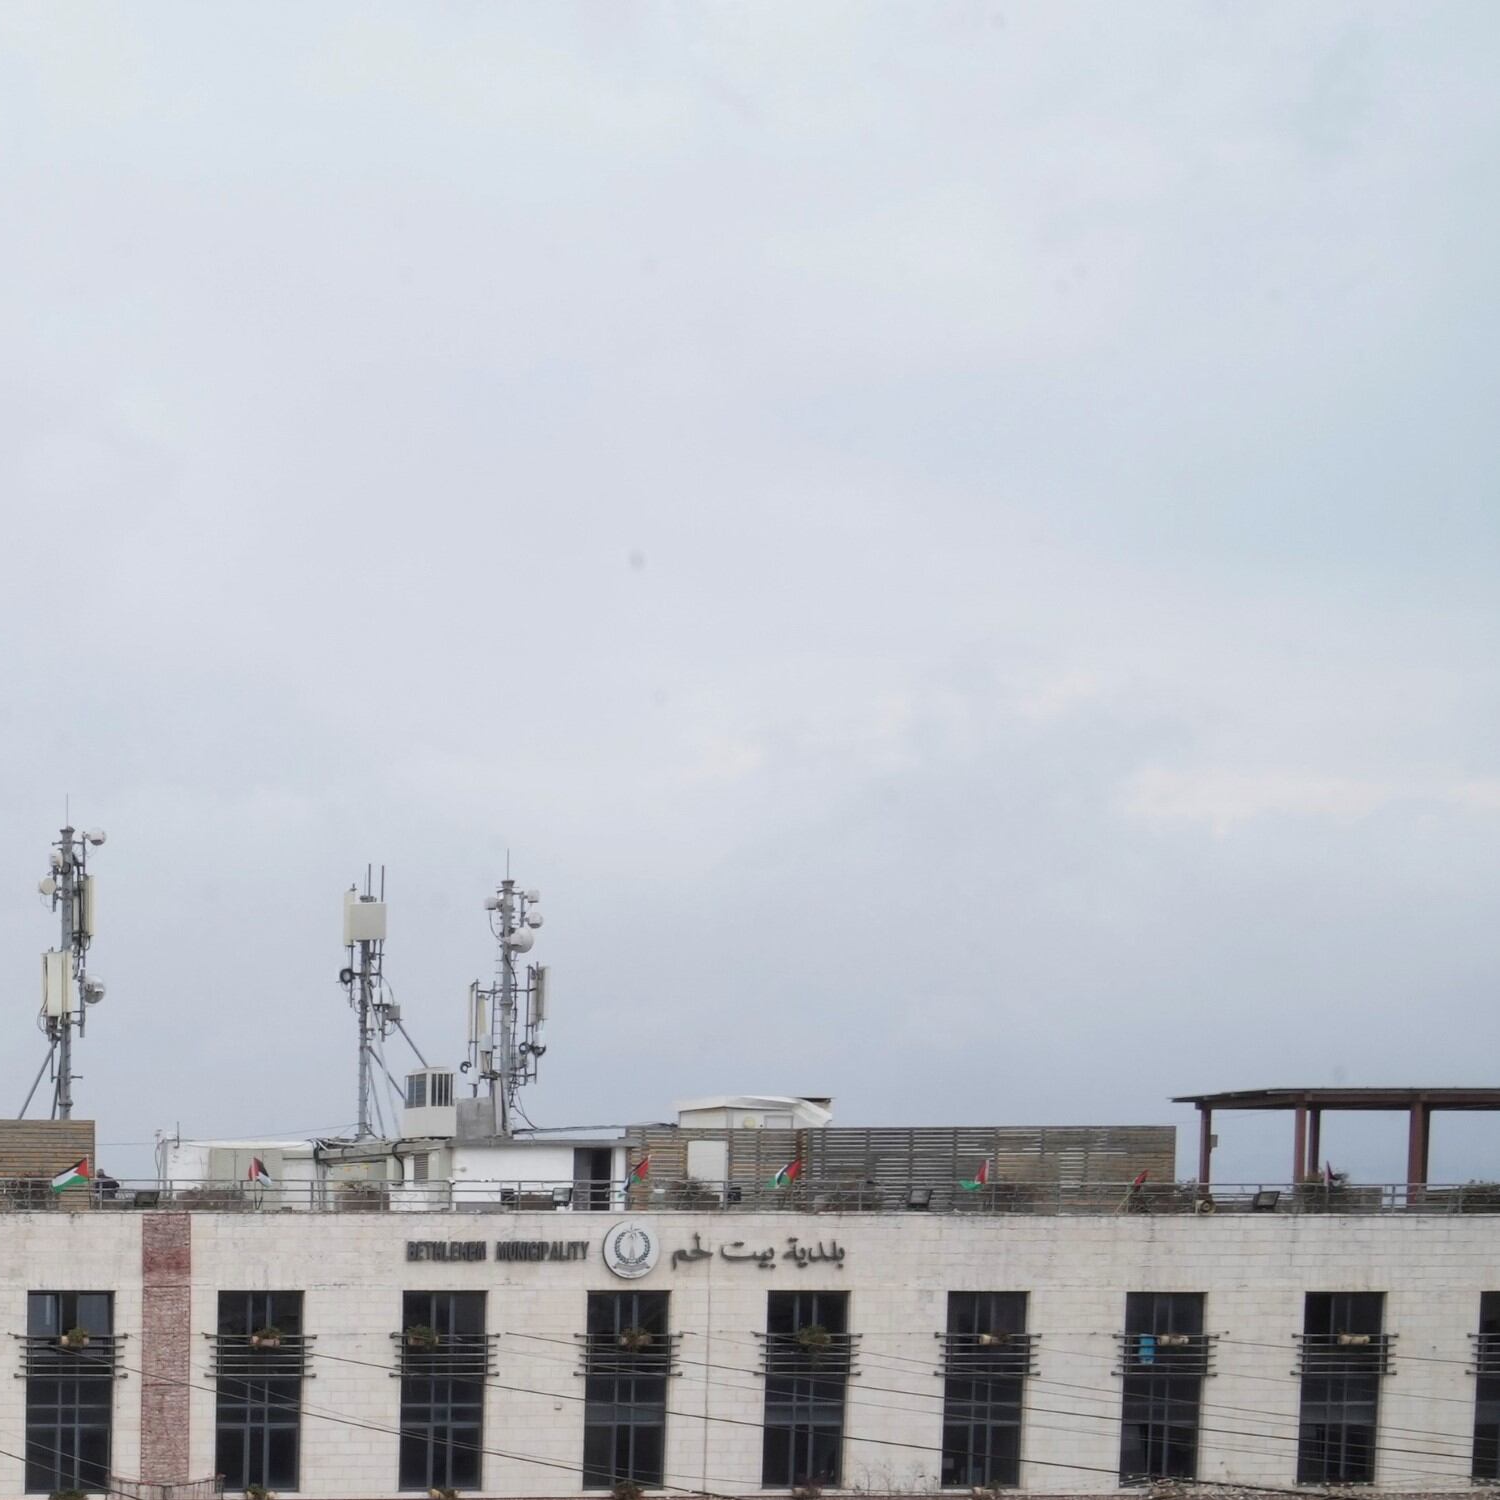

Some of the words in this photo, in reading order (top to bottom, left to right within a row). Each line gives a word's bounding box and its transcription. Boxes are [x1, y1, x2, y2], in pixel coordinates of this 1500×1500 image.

[406, 1241, 487, 1262] BETHLEHEM
[496, 1240, 590, 1262] MUNICIPALITY
[671, 1232, 714, 1271] لحم
[720, 1241, 776, 1269] بيت
[782, 1237, 846, 1269] بلدية
